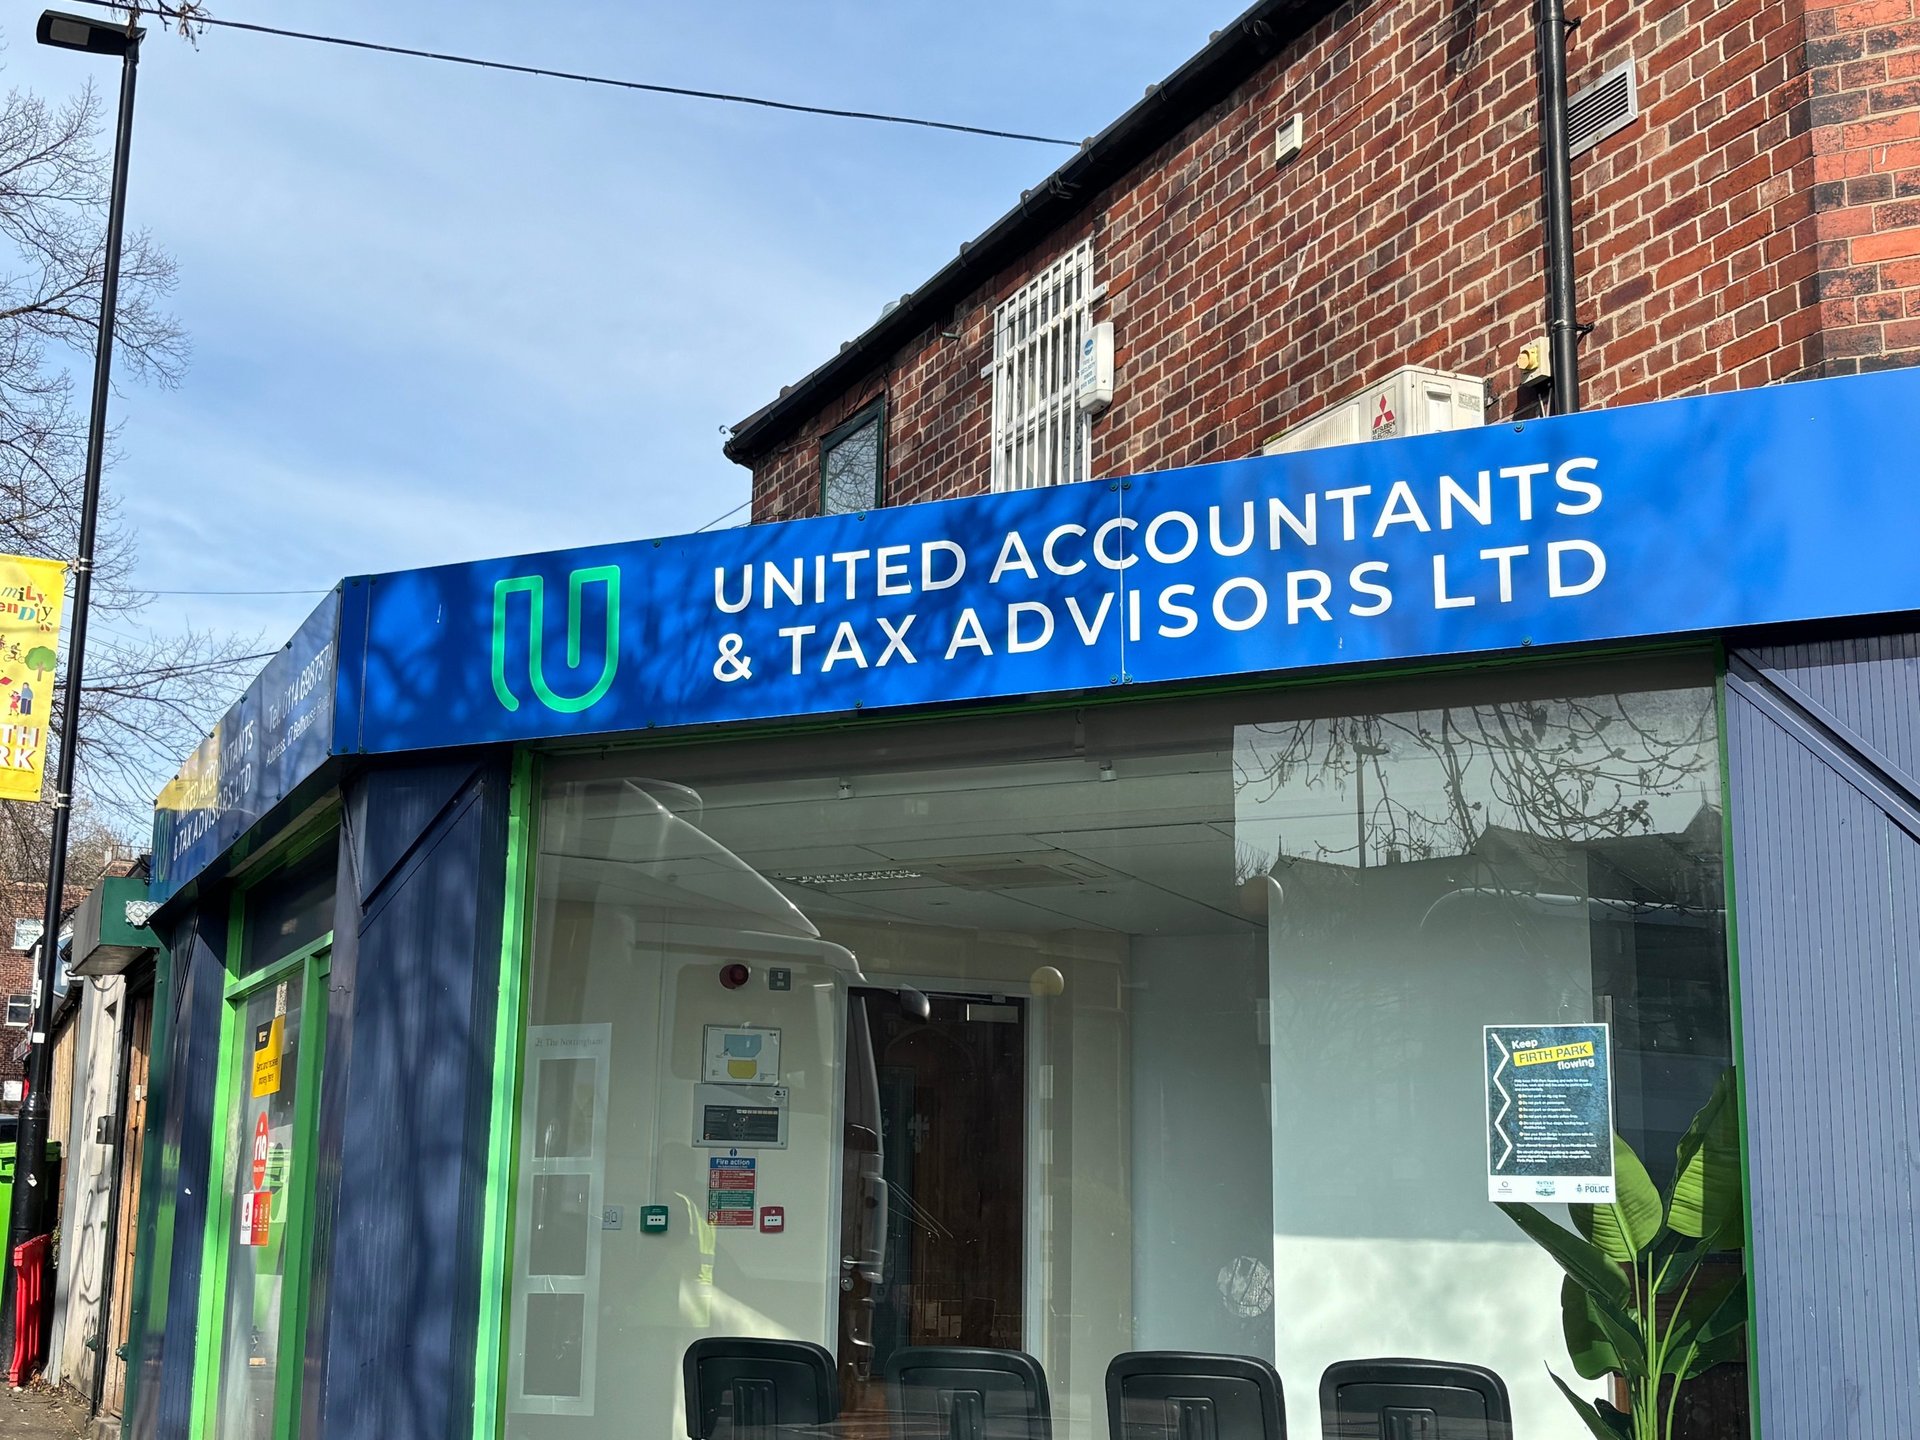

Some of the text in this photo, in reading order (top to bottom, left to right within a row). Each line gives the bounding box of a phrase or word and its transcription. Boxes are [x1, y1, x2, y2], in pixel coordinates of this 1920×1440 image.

[714, 457, 1603, 614] UNITED ACCOUNTANTS
[713, 539, 1607, 682] & TAX ADVISORS LTD
[200, 720, 254, 799] ACCOUNTANTS
[179, 820, 193, 857] TAX
[193, 785, 233, 840] ADVISORS
[234, 762, 252, 802] LTD
[1511, 1038, 1538, 1050] Keep
[1519, 1045, 1588, 1064] FIRTH PARK
[1557, 1058, 1595, 1070] flowing
[1584, 1185, 1609, 1193] POLICE
